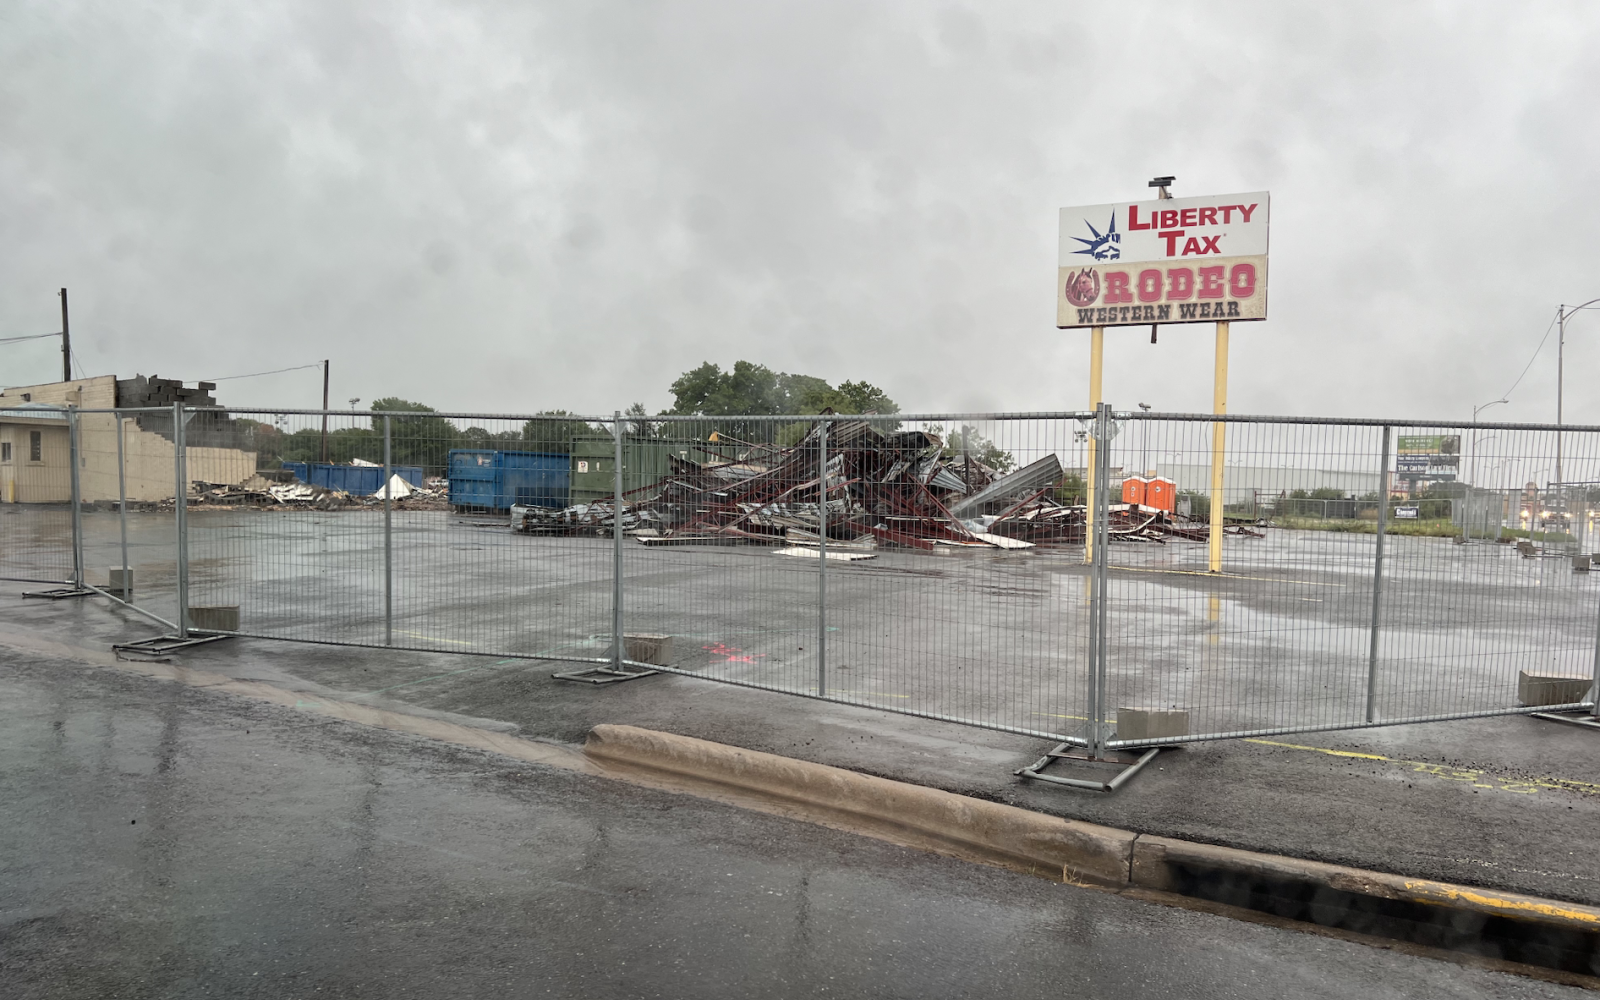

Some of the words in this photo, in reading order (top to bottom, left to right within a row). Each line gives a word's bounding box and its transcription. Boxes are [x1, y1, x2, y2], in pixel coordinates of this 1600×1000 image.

[1128, 203, 1258, 231] LIBERTY
[1158, 230, 1222, 257] TAX
[1104, 263, 1257, 304] RODEO
[1077, 304, 1171, 324] WESTERN
[1179, 301, 1240, 319] WEAR
